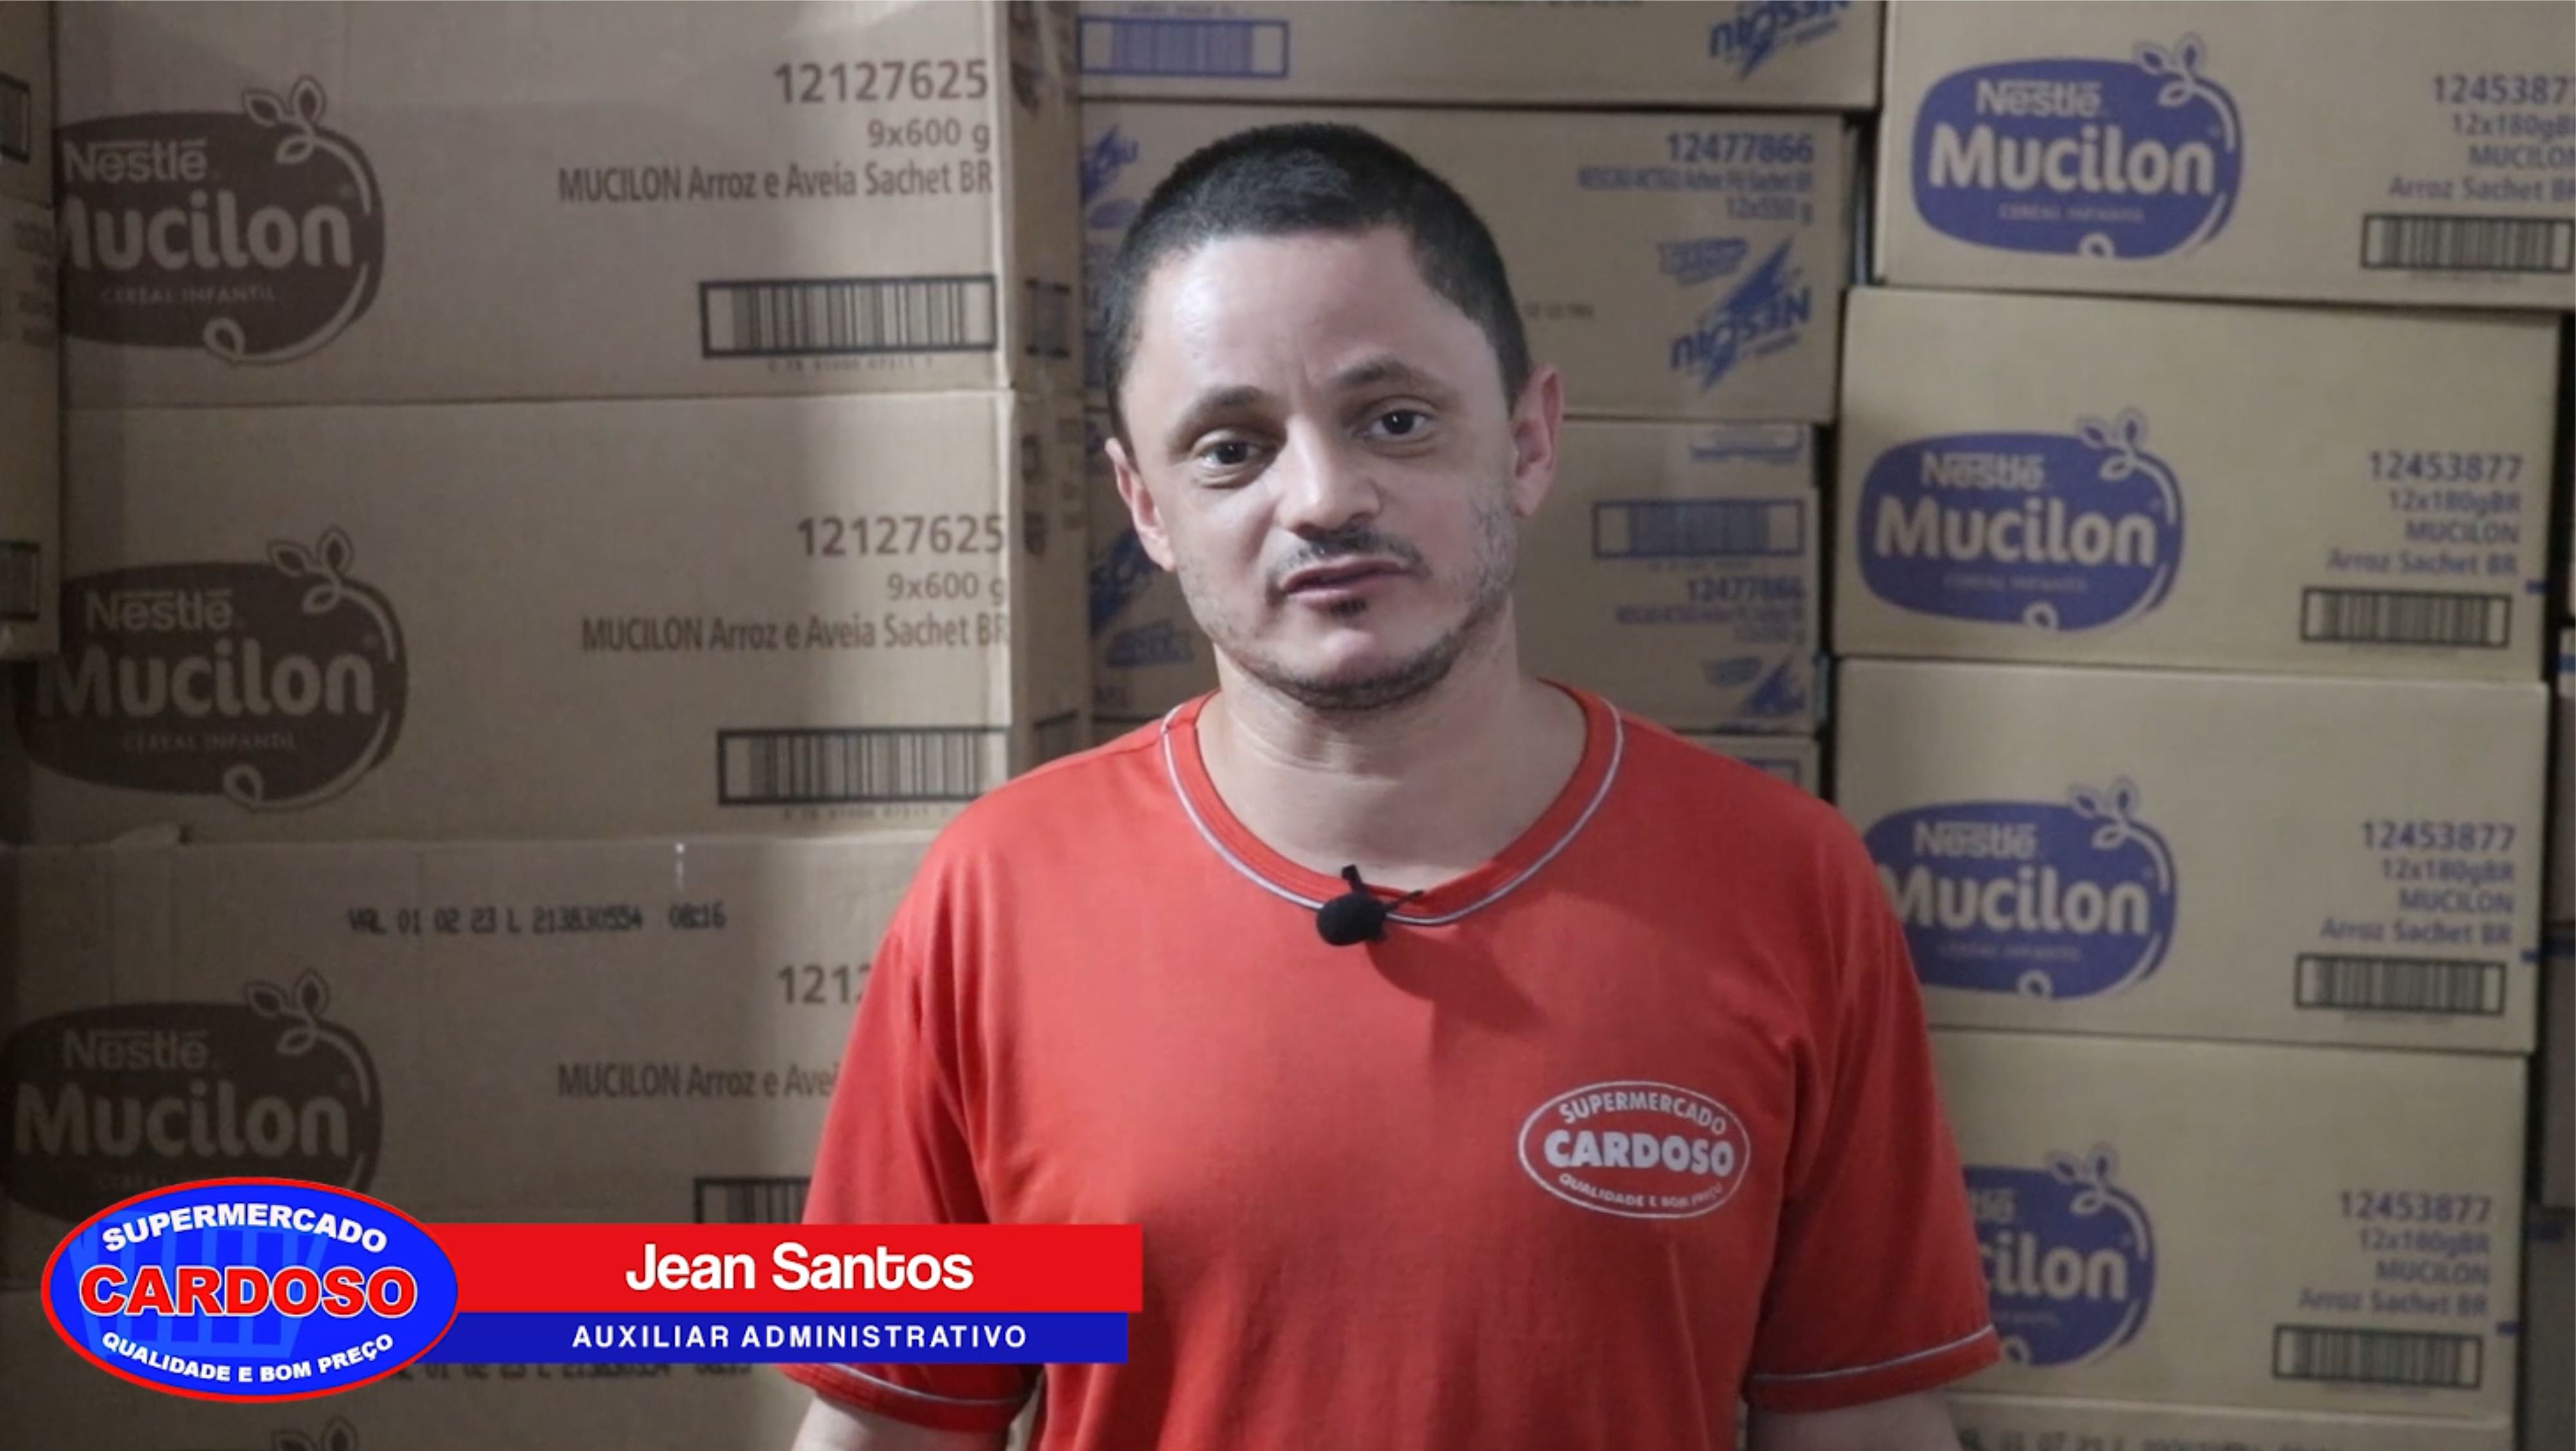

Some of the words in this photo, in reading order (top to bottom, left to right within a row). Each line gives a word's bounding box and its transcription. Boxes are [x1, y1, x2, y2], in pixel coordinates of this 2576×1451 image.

[774, 59, 989, 104] 12127625
[2433, 74, 2576, 104] 1245387
[868, 118, 961, 148] 9x600
[973, 123, 991, 154] g
[2454, 113, 2576, 141] 12x180gB
[1928, 123, 2214, 194] Mucilon
[559, 167, 681, 203] MUCILON
[689, 166, 756, 199] Arroz
[765, 172, 779, 197] e
[786, 163, 857, 197] Aveia
[865, 161, 951, 197] Sachet
[961, 160, 992, 194] BR
[2369, 452, 2523, 482] 12453877
[797, 515, 1004, 557] 12127625
[1874, 495, 2156, 567] Mucilon
[886, 572, 979, 601] 9x600
[582, 617, 702, 652] MUCILON
[711, 617, 776, 650] Arroz
[785, 622, 801, 649] e
[807, 613, 875, 649] Aveia
[884, 612, 967, 648] Sachet
[38, 637, 374, 718] Mucilon
[2362, 821, 2516, 851] 12453877
[1874, 864, 2149, 935] Mucilon
[397, 909, 421, 933] 01
[434, 908, 458, 933] 02
[471, 907, 495, 932] 23
[507, 908, 521, 932] L
[558, 1064, 681, 1096] MUCILON
[686, 1064, 756, 1095] Arroz
[763, 1070, 778, 1097] e
[784, 1060, 841, 1097] Avei
[15, 1079, 349, 1158] Mucilon
[1559, 1091, 1727, 1135] SUPERMERCADO
[1544, 1129, 1735, 1177] CARDOSO
[1559, 1173, 1644, 1207] QUALIDADE
[1649, 1196, 1657, 1207] E
[1661, 1197, 1688, 1208] BOM
[2341, 1191, 2492, 1223] 12453877
